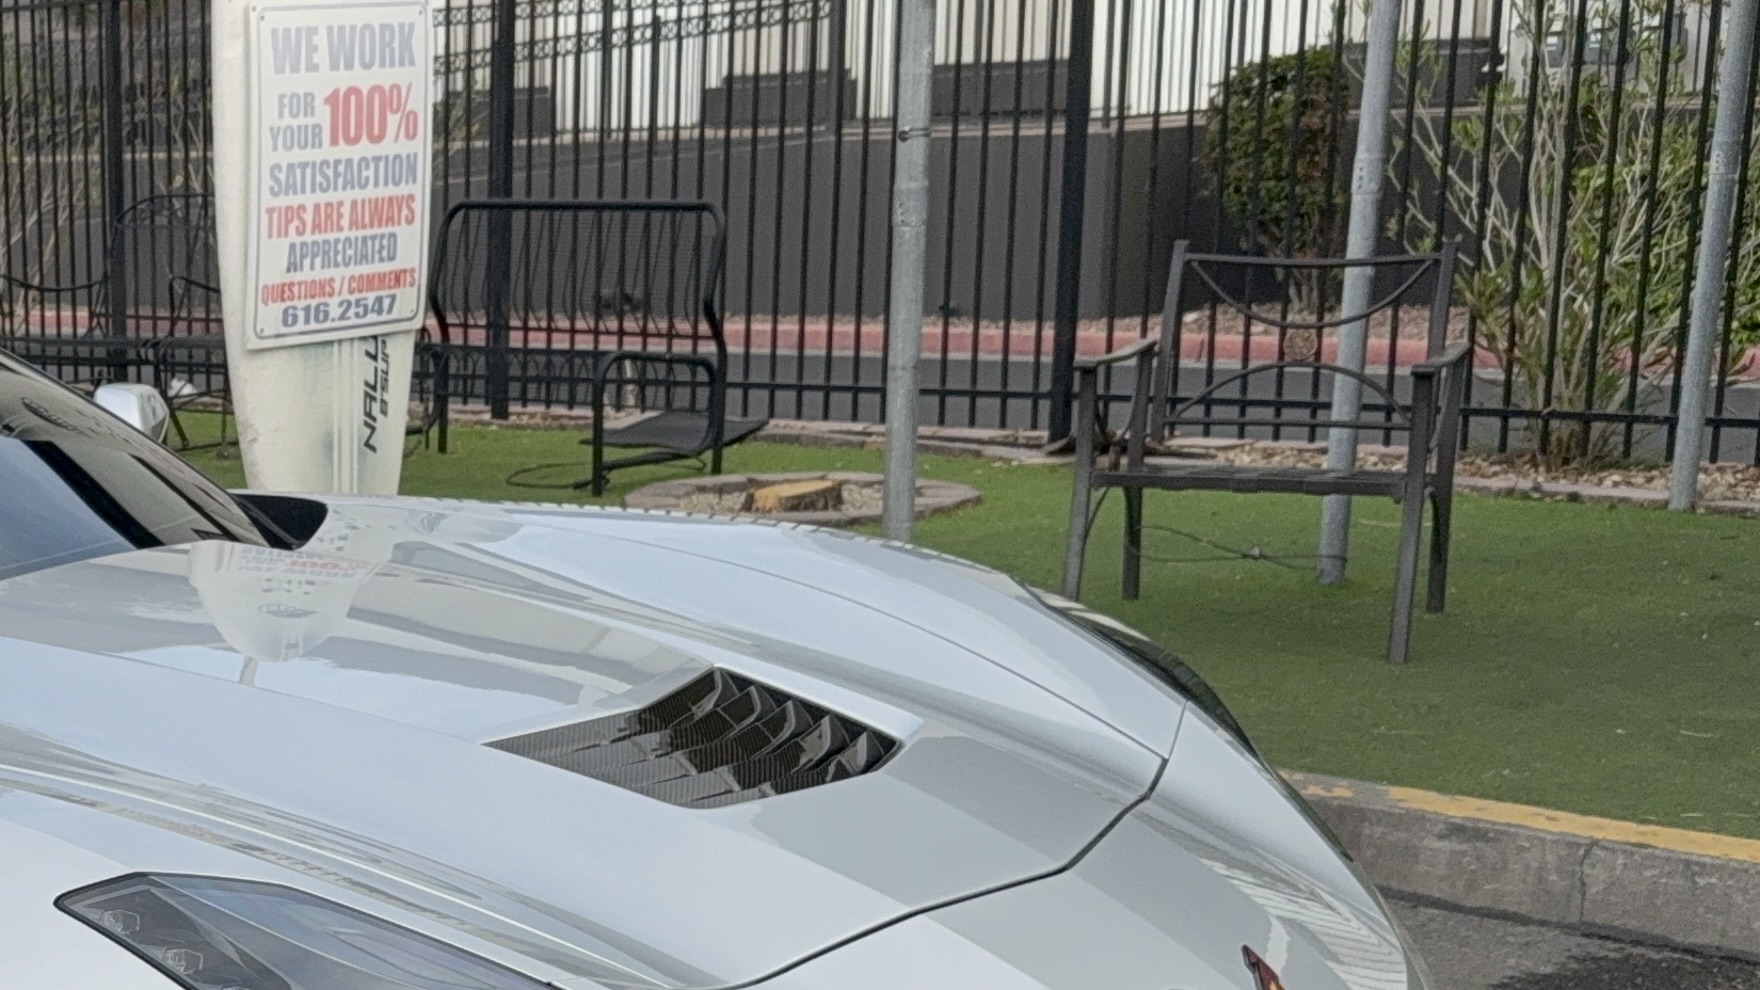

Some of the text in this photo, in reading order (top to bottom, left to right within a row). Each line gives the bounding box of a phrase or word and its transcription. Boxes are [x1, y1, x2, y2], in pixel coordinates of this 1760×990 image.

[270, 22, 416, 75] WE WORK
[269, 82, 418, 152] YOUR 100%
[277, 92, 316, 120] FOR
[269, 152, 418, 198] SATISFACTION
[265, 193, 416, 240] TIPS ARE ALWAYS
[286, 232, 398, 274] APPRECIATED
[261, 276, 336, 306] QUESTIONS
[347, 267, 416, 296] COMMENTS
[281, 294, 397, 328] 616.2547
